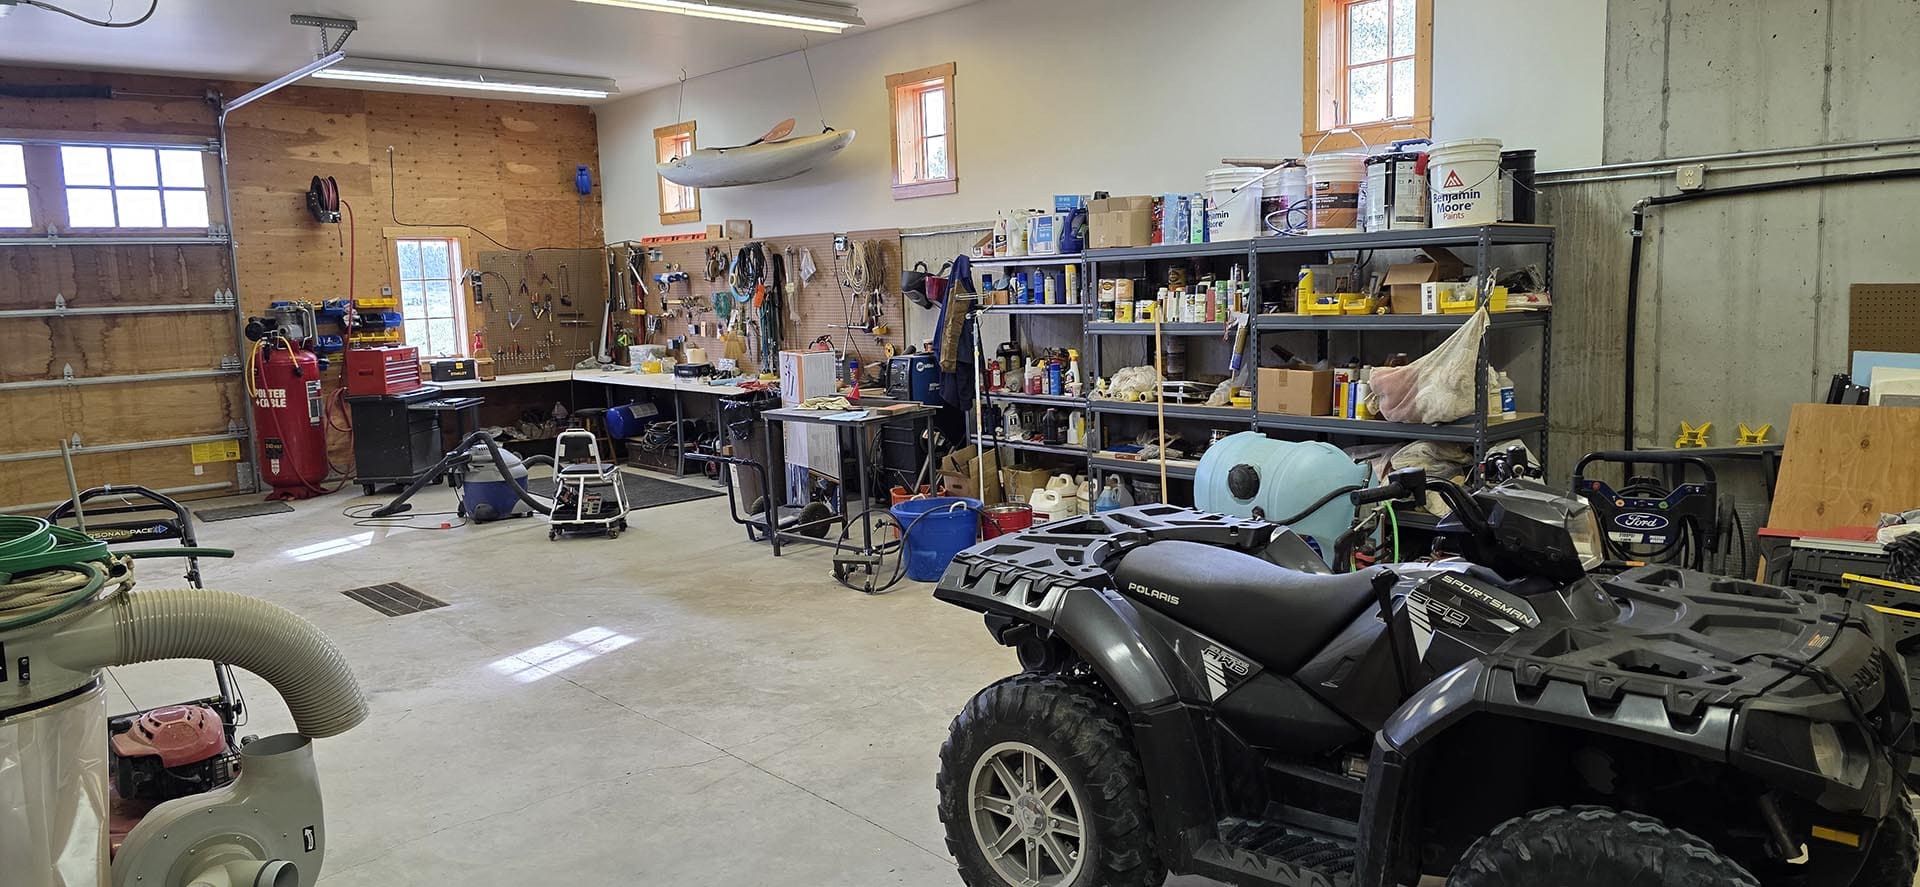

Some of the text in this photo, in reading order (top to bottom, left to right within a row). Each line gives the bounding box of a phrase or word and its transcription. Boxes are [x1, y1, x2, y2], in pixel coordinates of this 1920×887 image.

[1433, 189, 1480, 203] Benjamin
[1437, 202, 1472, 213] Moore
[1443, 211, 1465, 220] Paints
[1625, 514, 1658, 527] Ford
[88, 527, 154, 539] RSONAL PACE
[1128, 582, 1180, 605] POLARIS
[1441, 575, 1533, 625] SPORTSMAN
